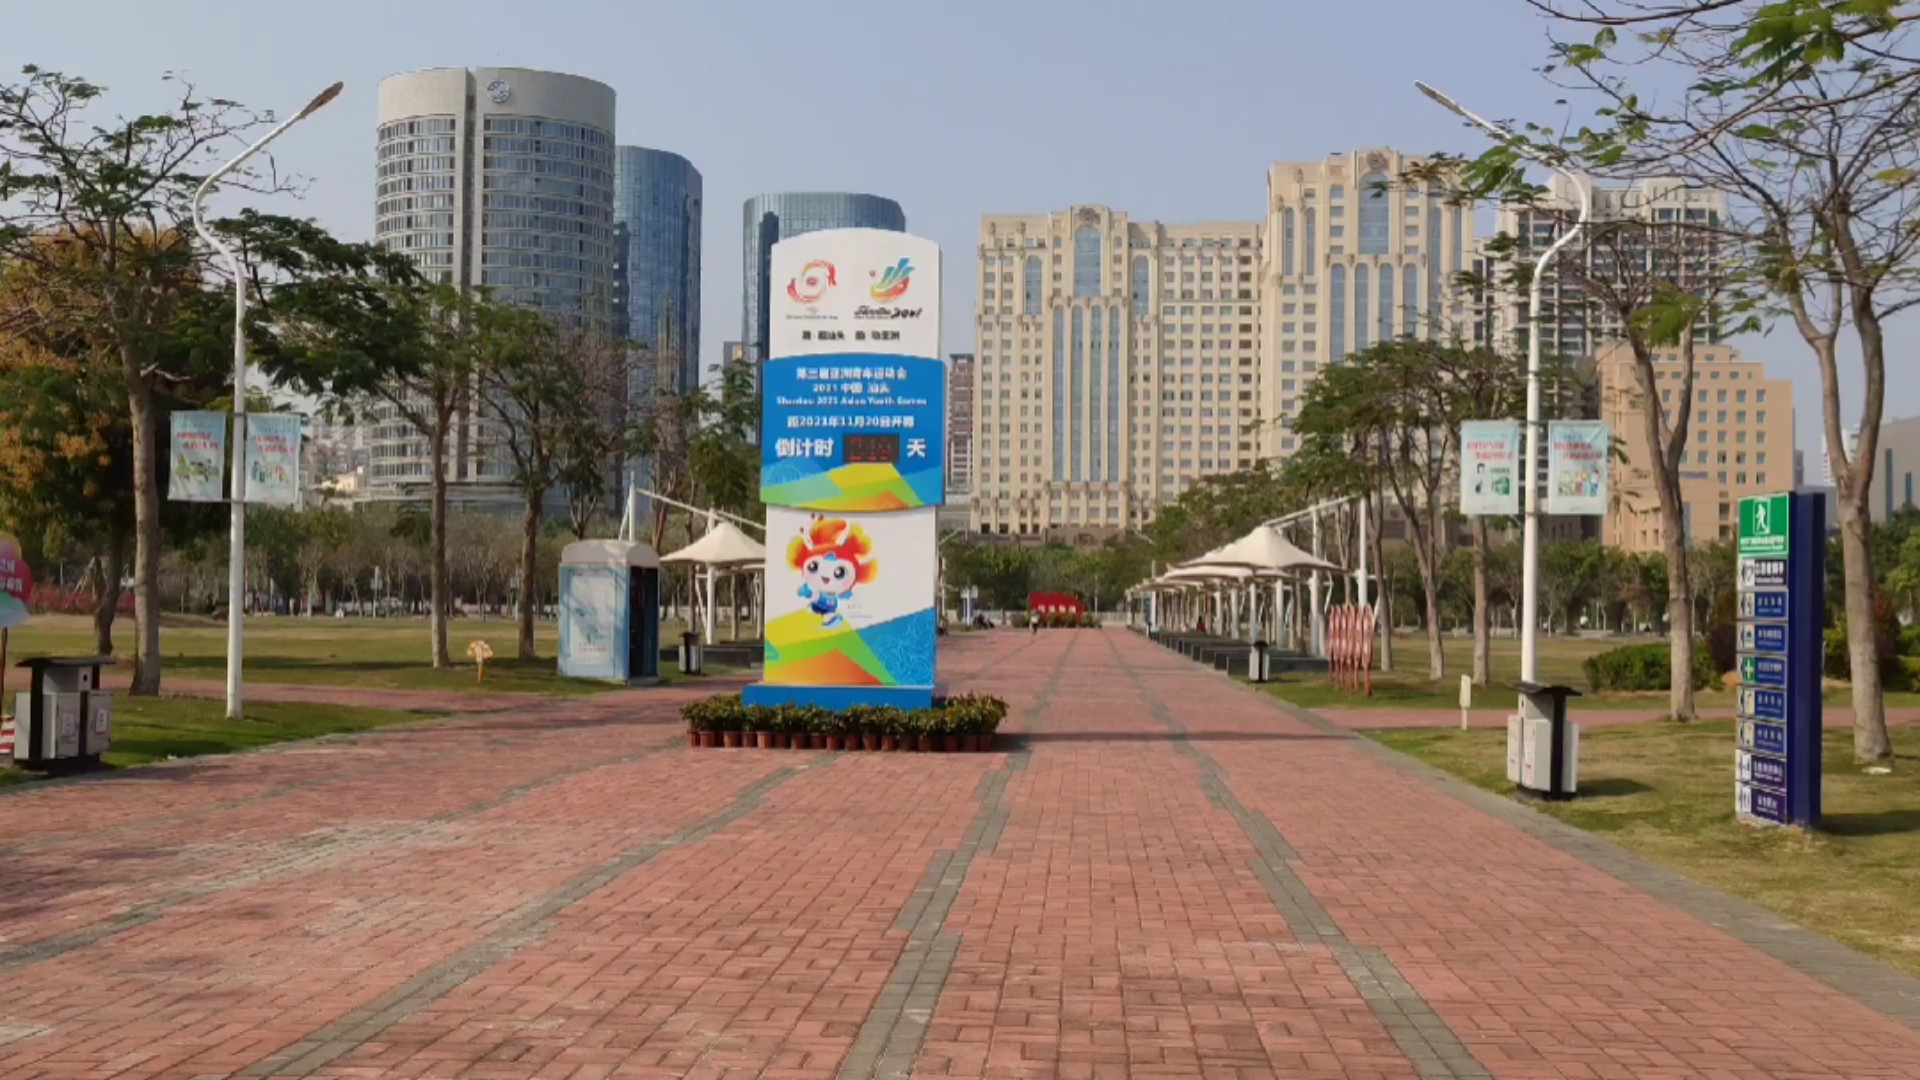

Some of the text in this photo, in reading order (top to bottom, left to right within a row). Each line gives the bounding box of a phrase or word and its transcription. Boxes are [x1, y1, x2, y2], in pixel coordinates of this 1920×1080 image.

[796, 366, 908, 380] 第三届亚洲青年运动会
[812, 382, 890, 394] 2021 中国 汕头
[817, 395, 838, 406] 2021
[840, 395, 867, 406] Asian
[867, 395, 896, 406] Youth
[897, 395, 927, 406] Games
[787, 415, 915, 428] 距2021年11月20日开幕
[775, 437, 834, 458] 倒计时
[906, 438, 927, 458] 天
